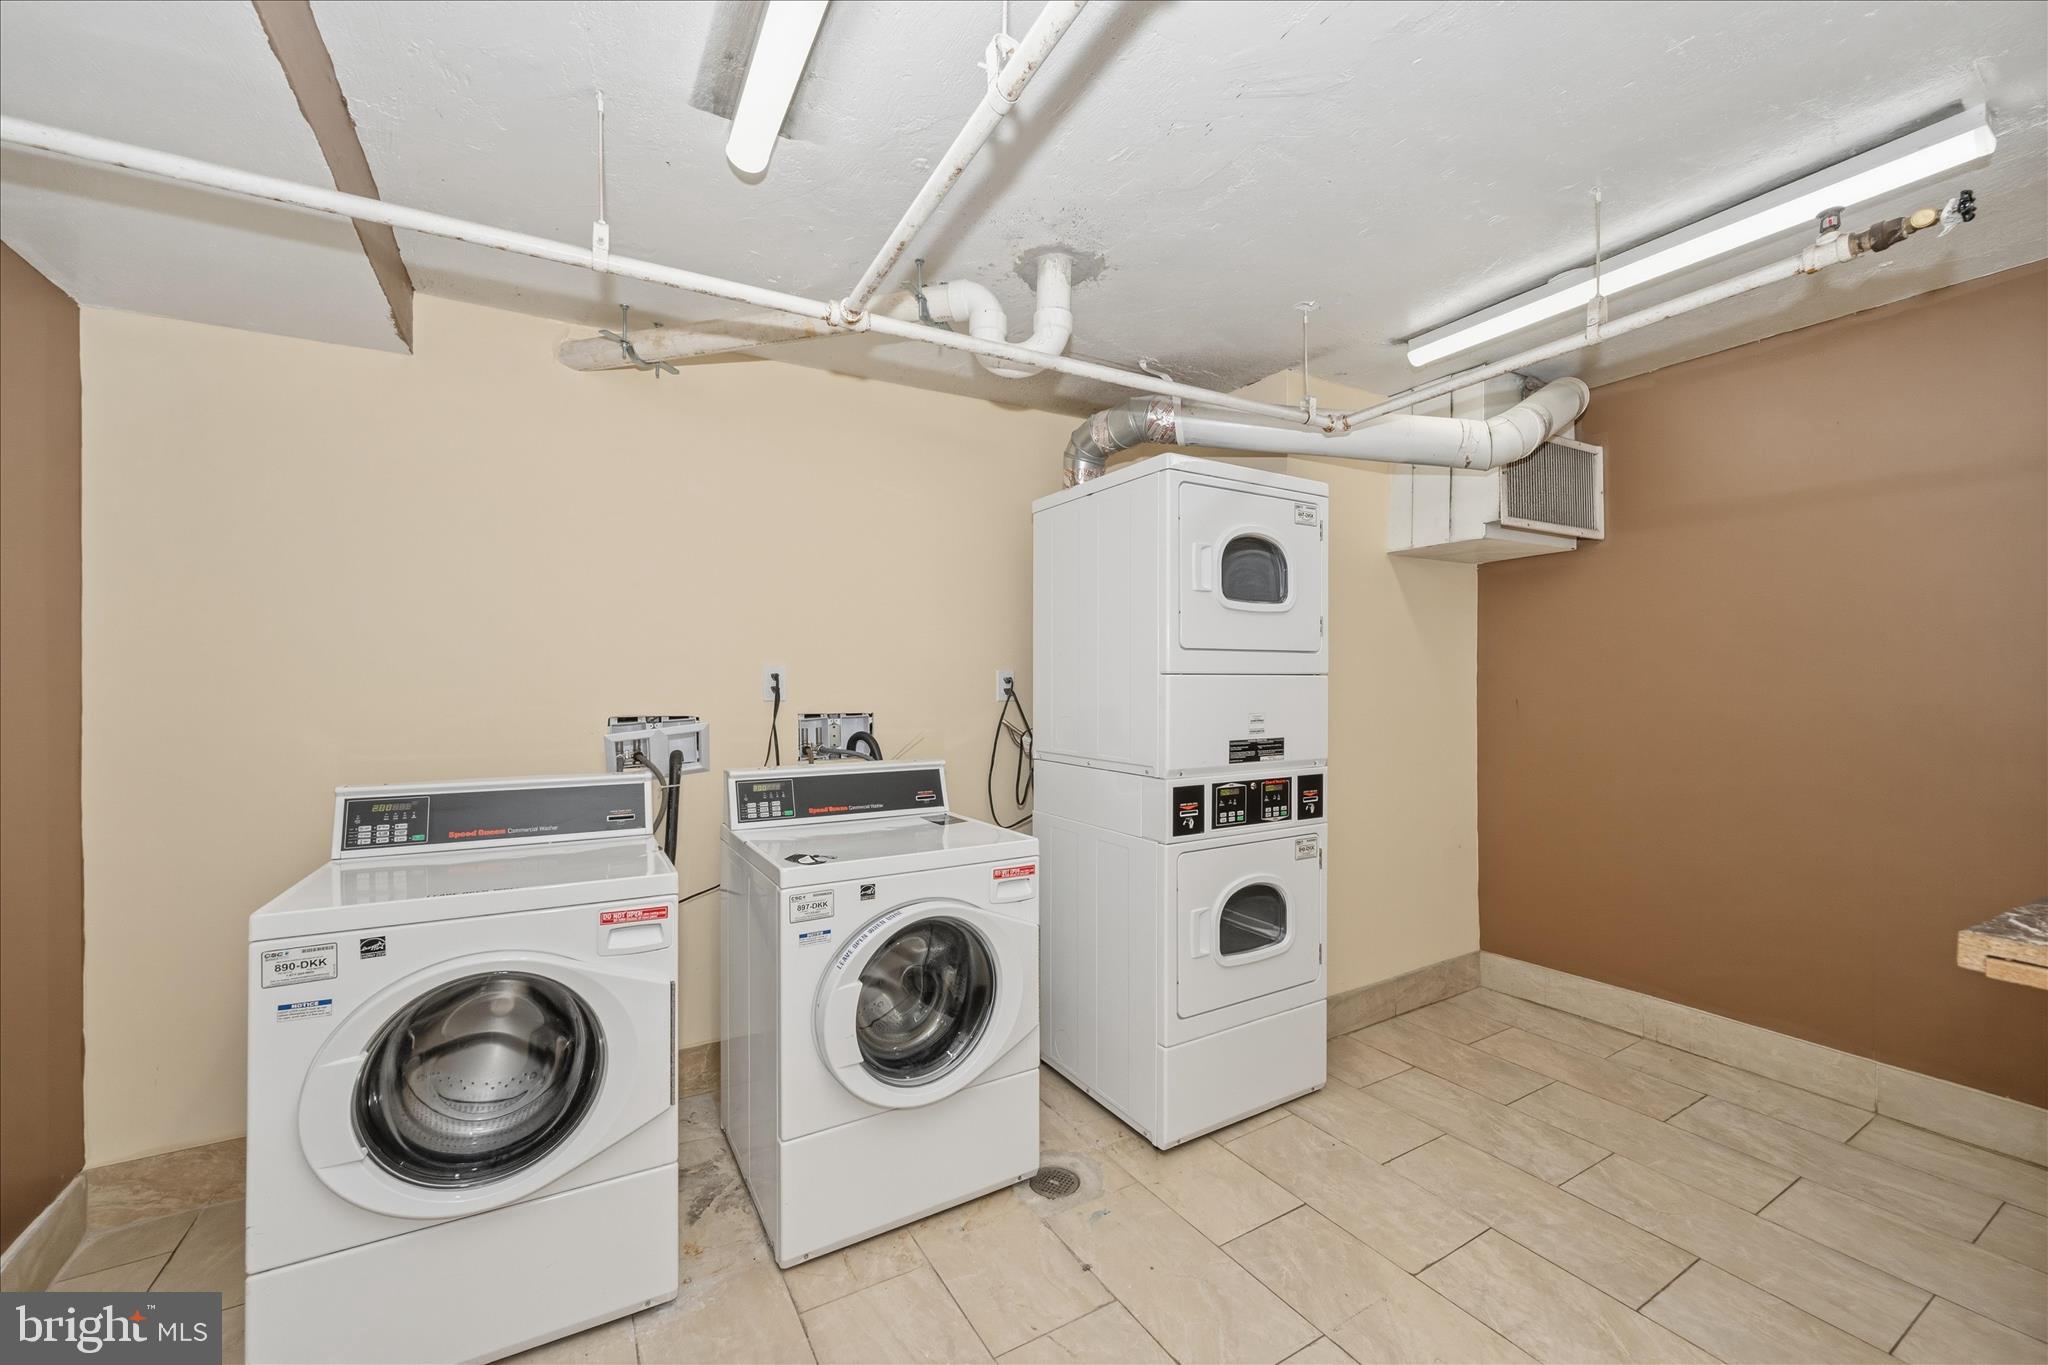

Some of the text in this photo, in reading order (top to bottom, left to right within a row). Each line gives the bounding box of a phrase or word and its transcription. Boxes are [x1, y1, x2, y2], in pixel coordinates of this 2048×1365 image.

[448, 830, 477, 839] Speed
[478, 828, 506, 837] Queen
[507, 825, 538, 834] Commercial
[796, 901, 829, 912] 897-DKK
[836, 950, 853, 970] LEAVE
[852, 934, 868, 950] OPEN
[274, 958, 328, 973] 890-DKK
[291, 1000, 319, 1009] NOTICE
